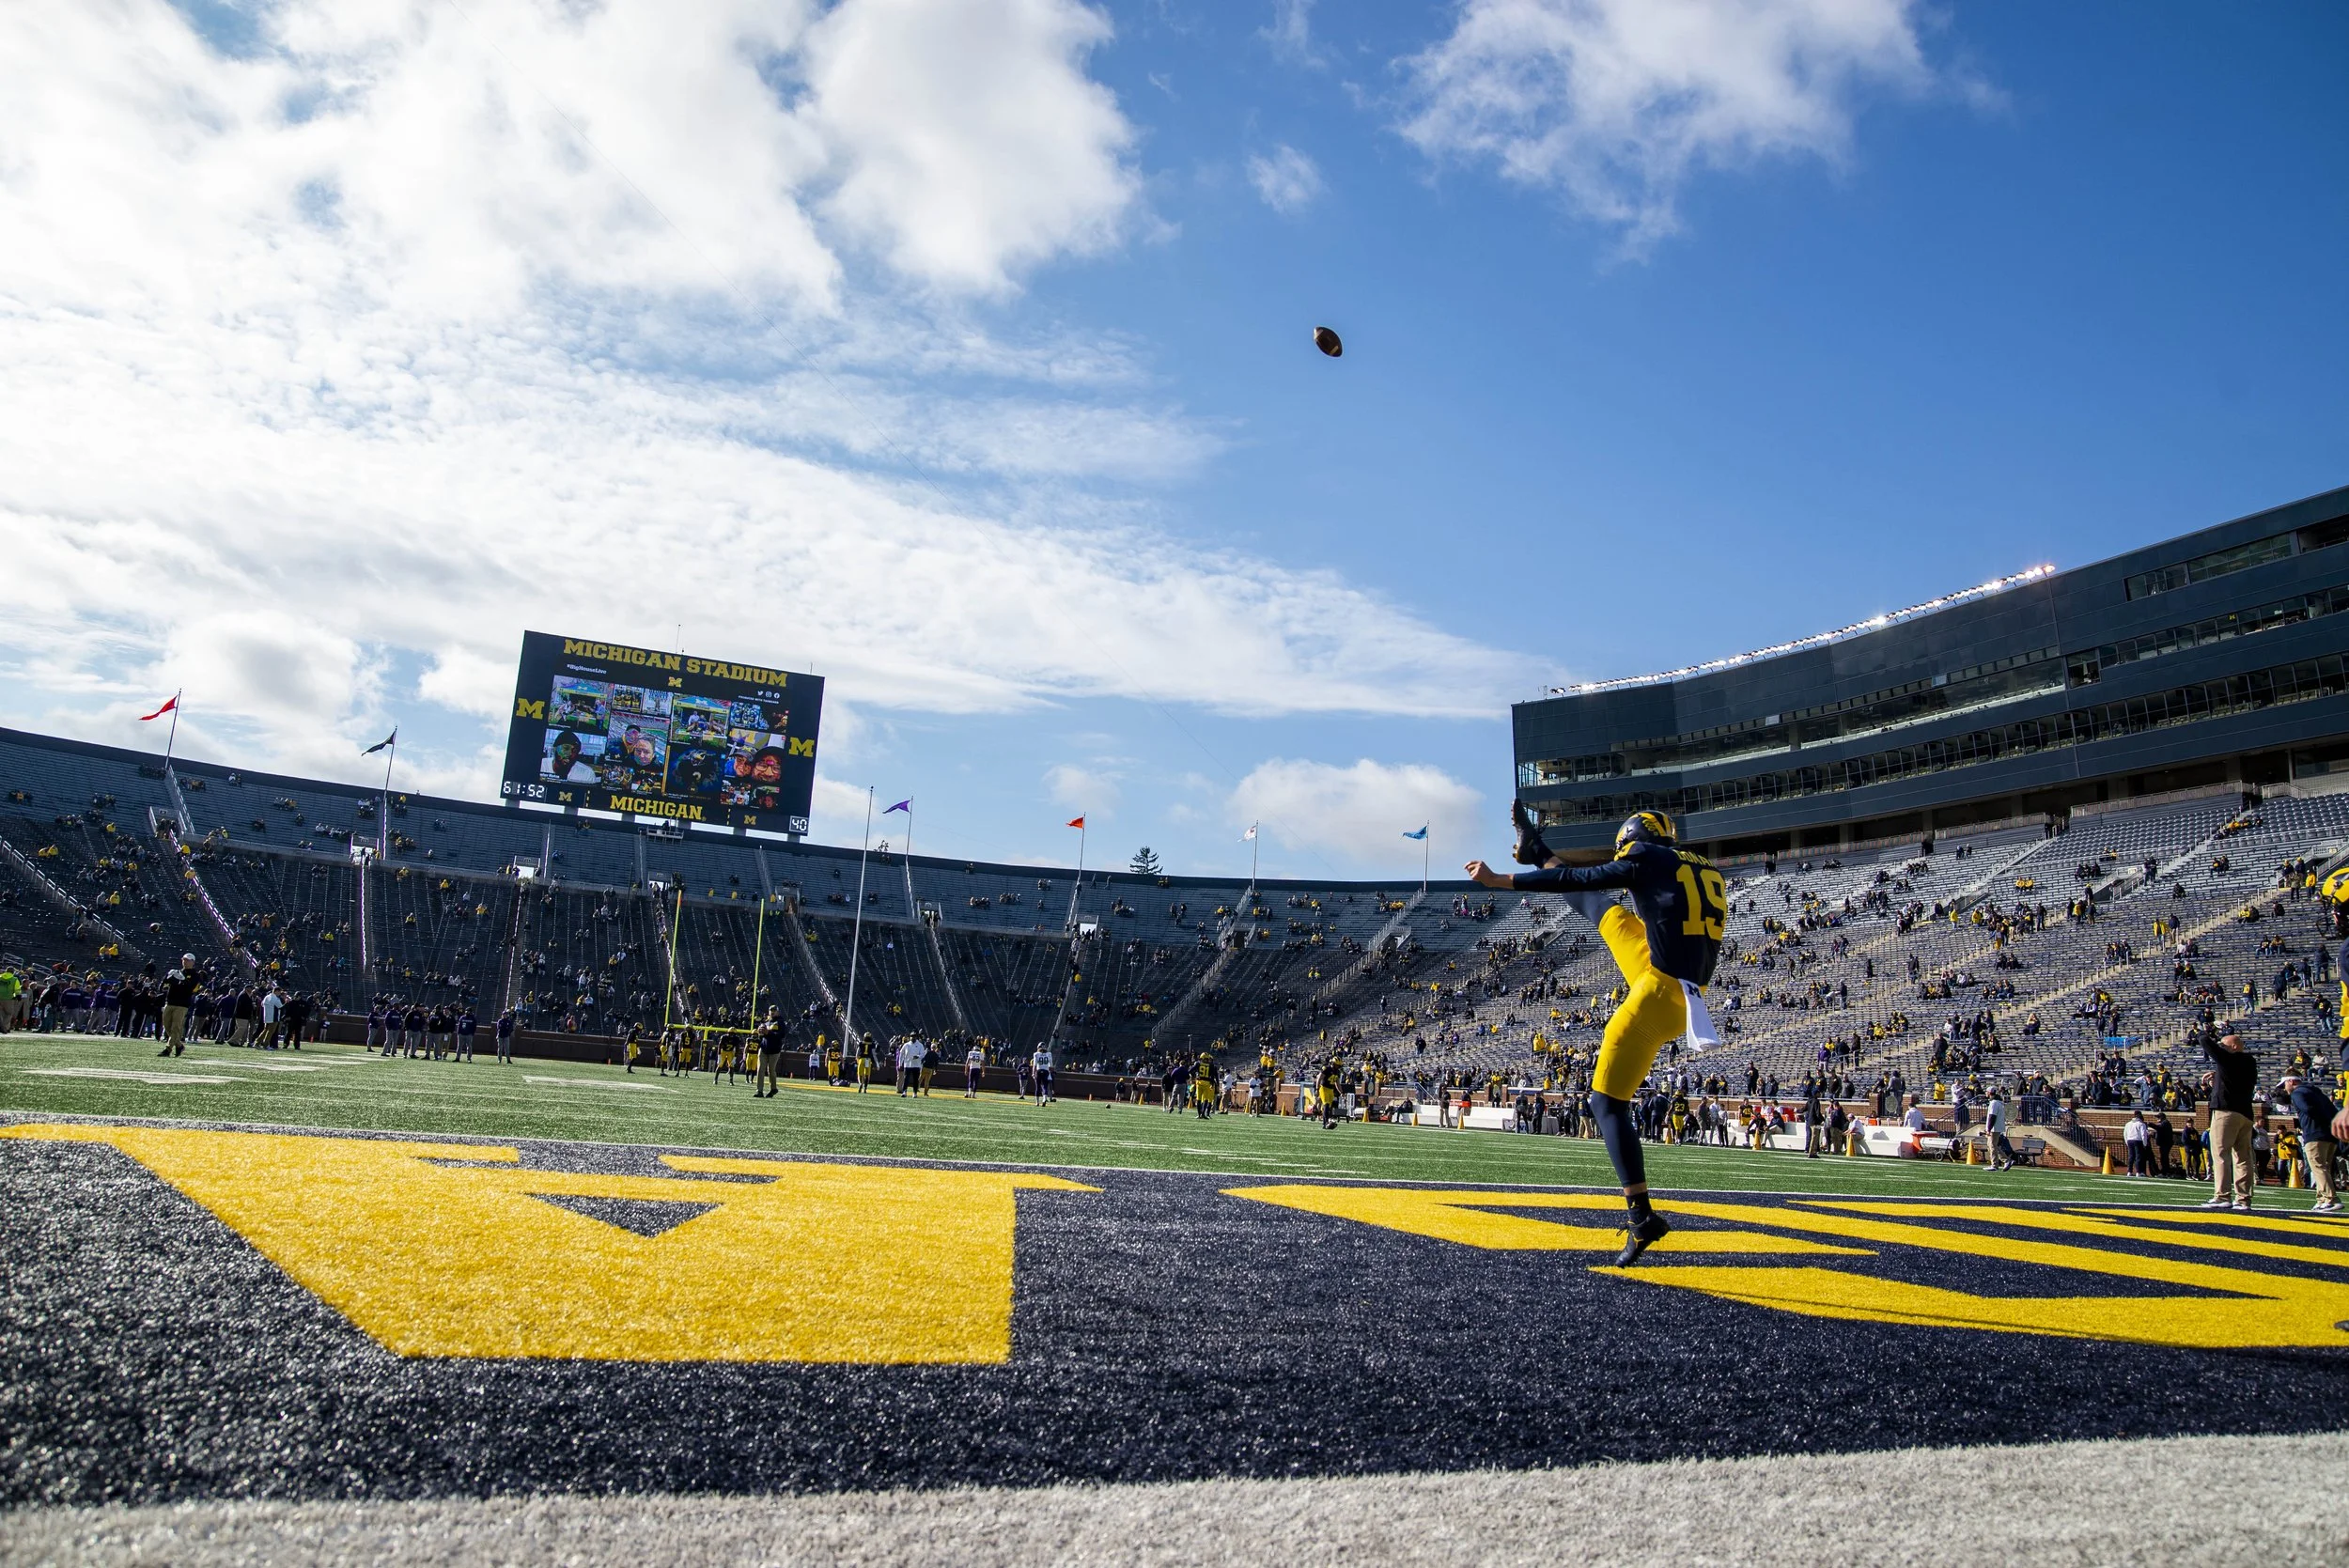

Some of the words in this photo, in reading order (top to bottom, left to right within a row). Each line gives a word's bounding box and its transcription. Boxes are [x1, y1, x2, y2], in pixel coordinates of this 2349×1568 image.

[564, 639, 681, 671] MICHIGAN
[686, 658, 788, 688] STADIUM
[667, 676, 684, 689] M
[516, 698, 545, 720] M
[788, 737, 815, 757] M
[503, 781, 545, 799] 61:52
[558, 791, 573, 802] M
[609, 795, 703, 820] MICHIGAN
[743, 815, 757, 826] M
[791, 818, 808, 831] 40
[1676, 864, 1728, 941] 19
[863, 1044, 869, 1055] 1
[1199, 1065, 1209, 1078] 91
[1674, 1103, 1685, 1112] 23
